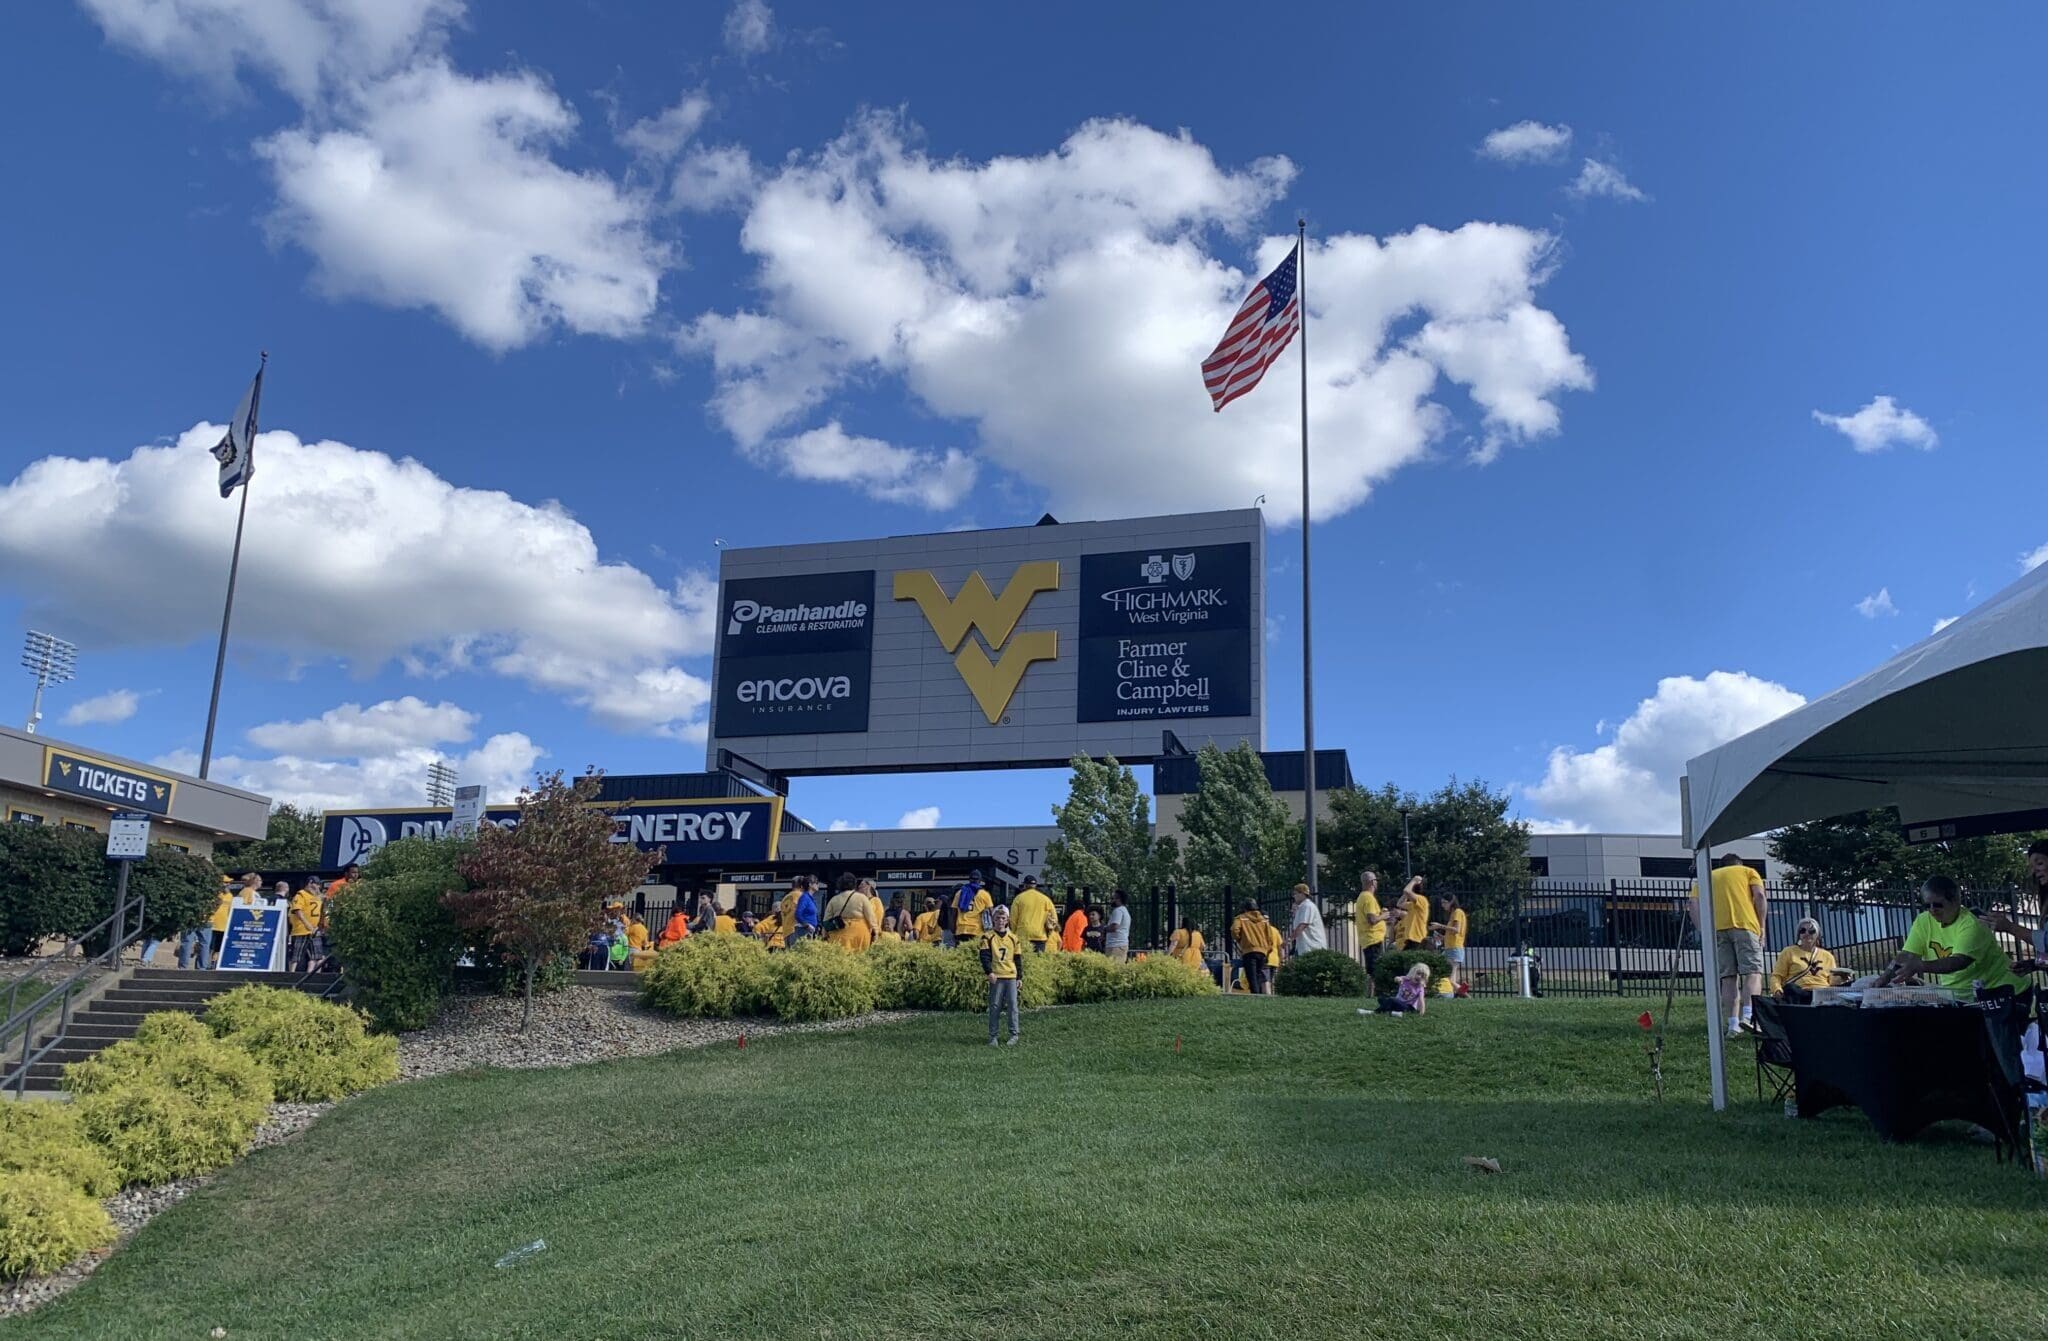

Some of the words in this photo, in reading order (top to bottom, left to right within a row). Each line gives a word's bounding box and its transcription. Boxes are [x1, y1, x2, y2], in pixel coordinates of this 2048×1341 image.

[1114, 588, 1224, 611] HIGHMARK
[758, 600, 868, 623] Panhandle
[1129, 610, 1160, 624] West
[1161, 608, 1209, 624] Virginia
[756, 622, 798, 634] CLEANING
[799, 622, 807, 632] &
[807, 618, 865, 632] RESTORATION
[1118, 639, 1188, 658] Farmer
[1117, 659, 1168, 679] Cline
[1171, 656, 1191, 678] &
[736, 675, 852, 702] encova
[1116, 677, 1211, 705] Campbell
[752, 703, 833, 713] INSURANCE
[1117, 707, 1154, 716] INJURY
[1158, 705, 1210, 714] LAWYERS
[77, 765, 149, 802] TICKETS
[608, 811, 752, 843] ENERGY
[887, 872, 907, 880] NORTH
